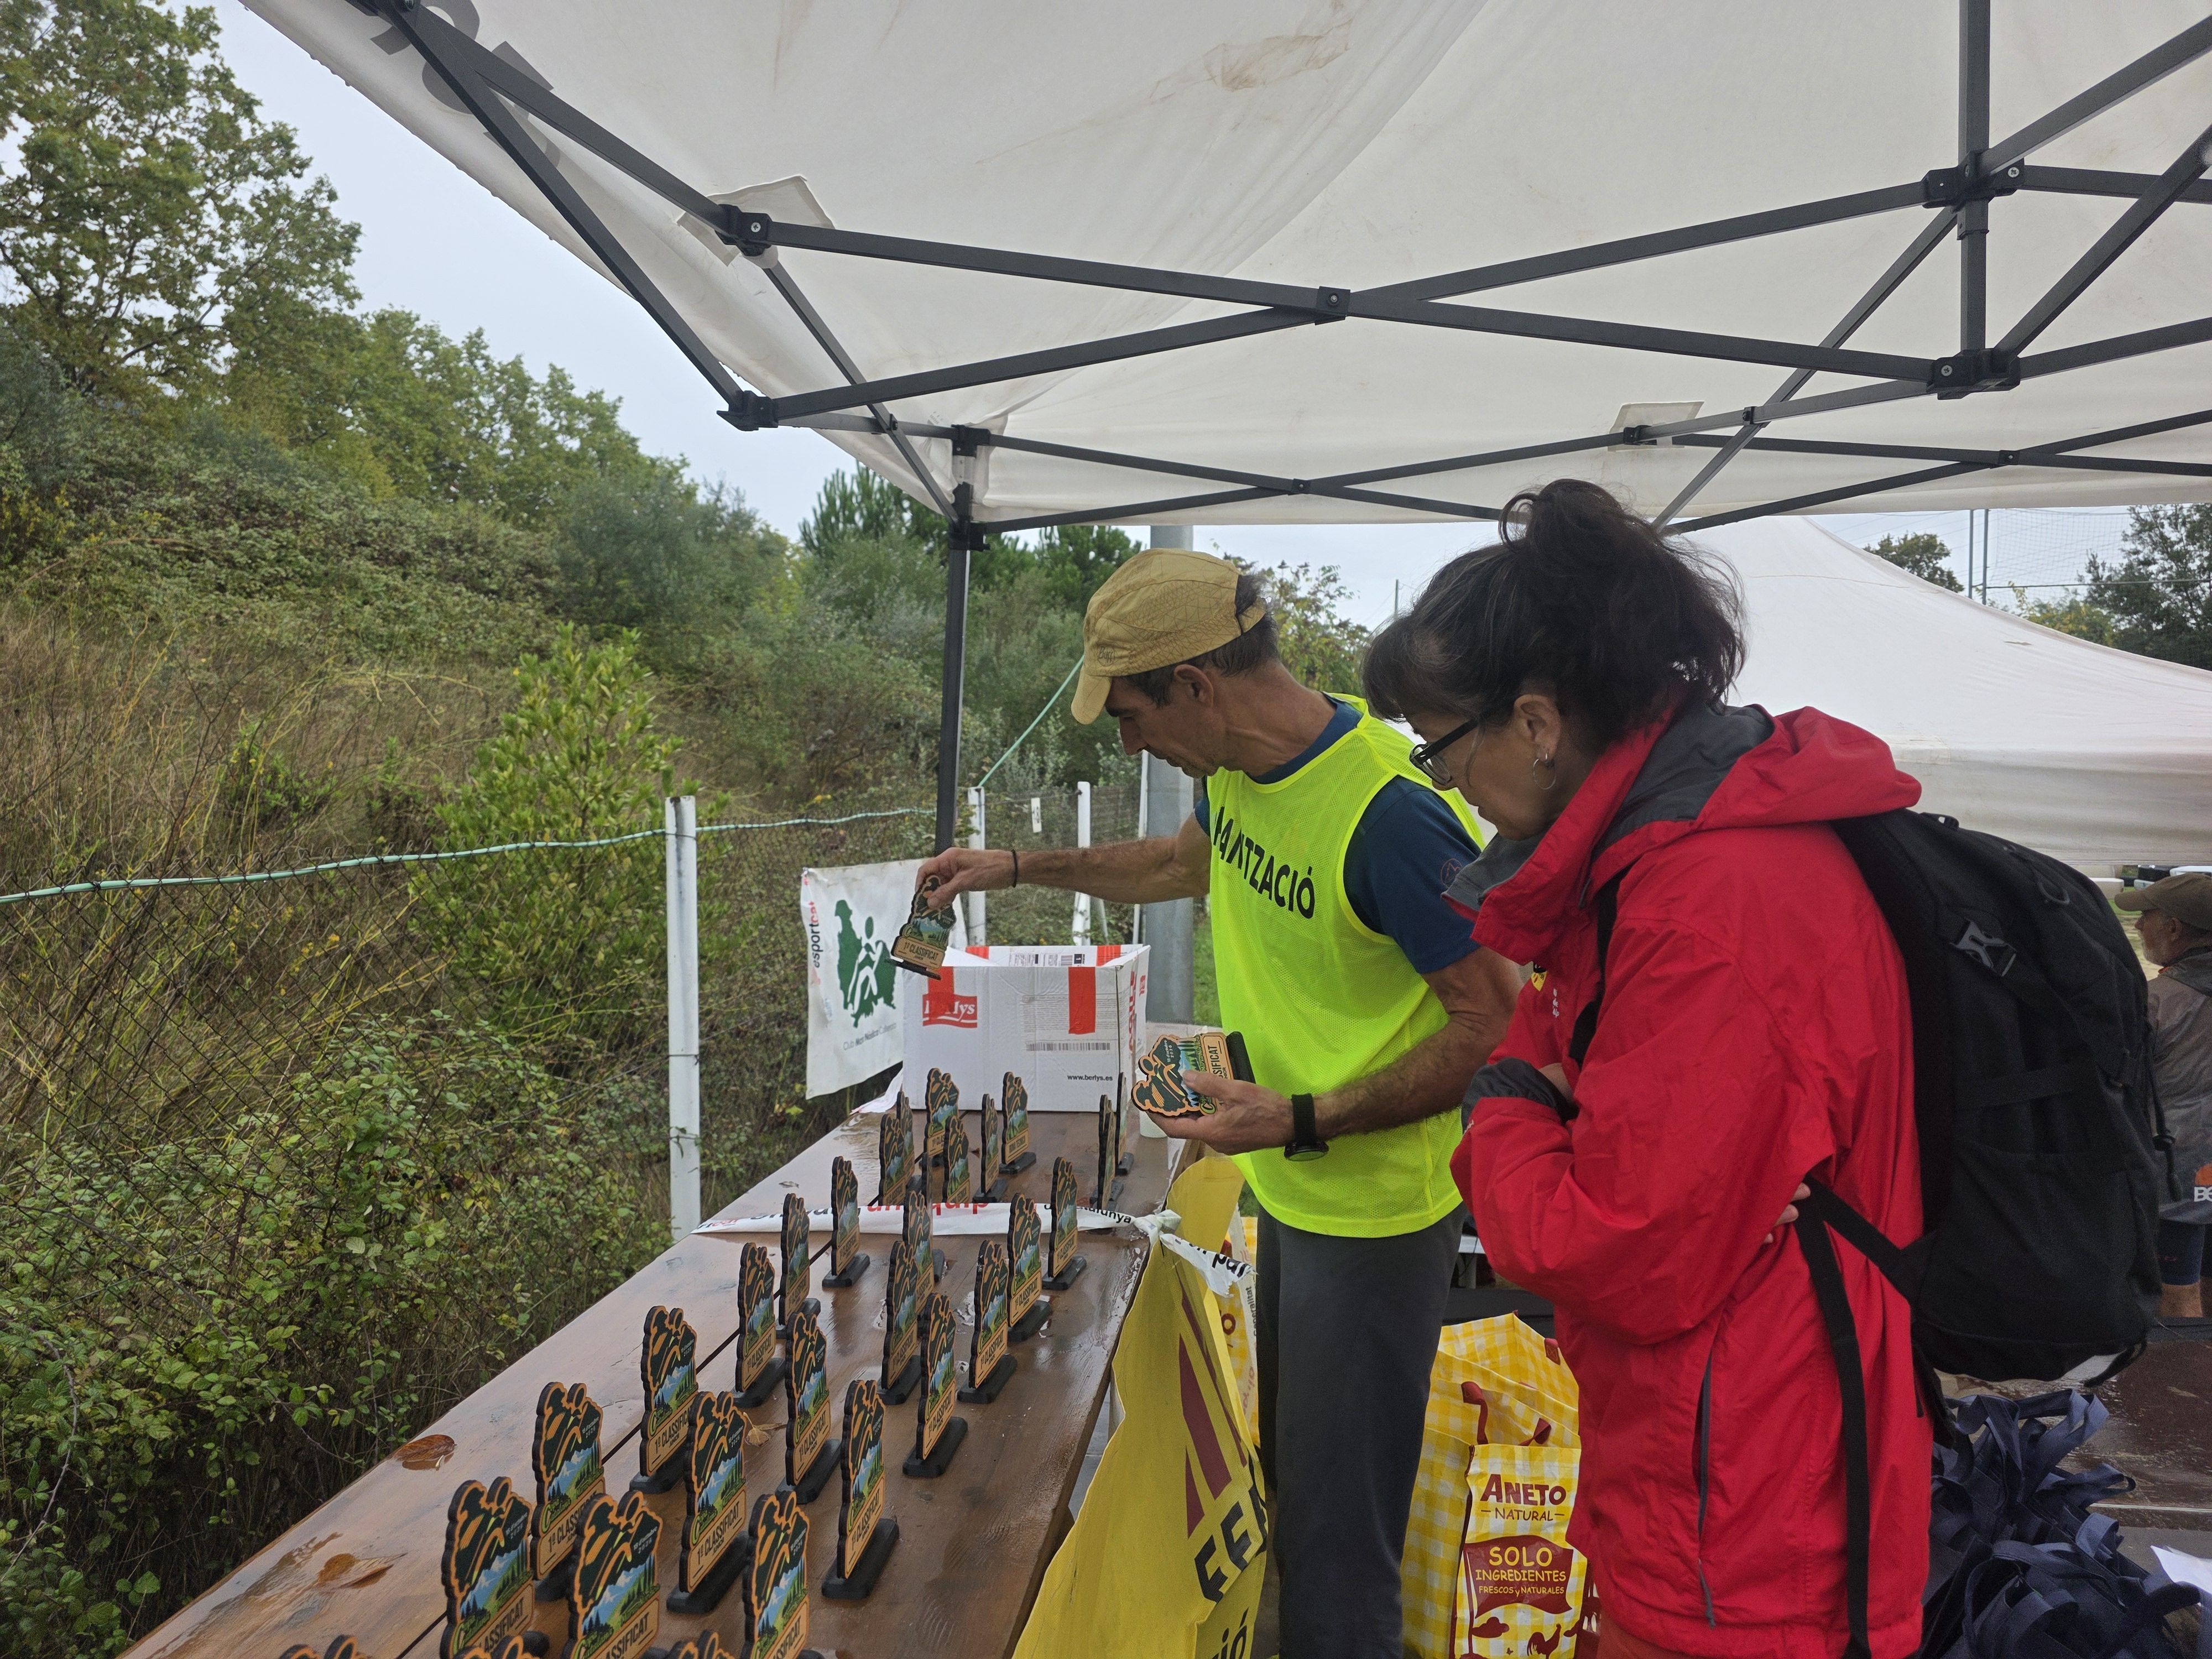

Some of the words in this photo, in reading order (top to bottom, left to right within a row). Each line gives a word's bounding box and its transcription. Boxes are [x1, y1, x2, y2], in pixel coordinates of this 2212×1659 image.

[909, 945, 938, 961] CLASSIFICAT
[1067, 1073, 1113, 1082] www.berlys.es
[1207, 1045, 1223, 1078] SIFICAT
[1019, 1277, 1038, 1308] CLASSIFICAT
[752, 1333, 772, 1369] CLASSIFICAT
[984, 1329, 1004, 1364] CLASSIFICAT
[661, 1408, 689, 1447] CLASSIFIC
[932, 1390, 953, 1432] CLASSIFICAT
[804, 1411, 827, 1452] CLASSIFICAT
[1480, 1474, 1567, 1506] ANETO
[704, 1501, 740, 1557] CLASSIFICAT
[856, 1487, 880, 1543] CLASSIFICAT
[1495, 1507, 1553, 1521] NATURAL
[1489, 1546, 1552, 1567] SOLO
[1475, 1569, 1566, 1582] INGREDIENTES
[484, 1597, 524, 1653] ASSIFICAT
